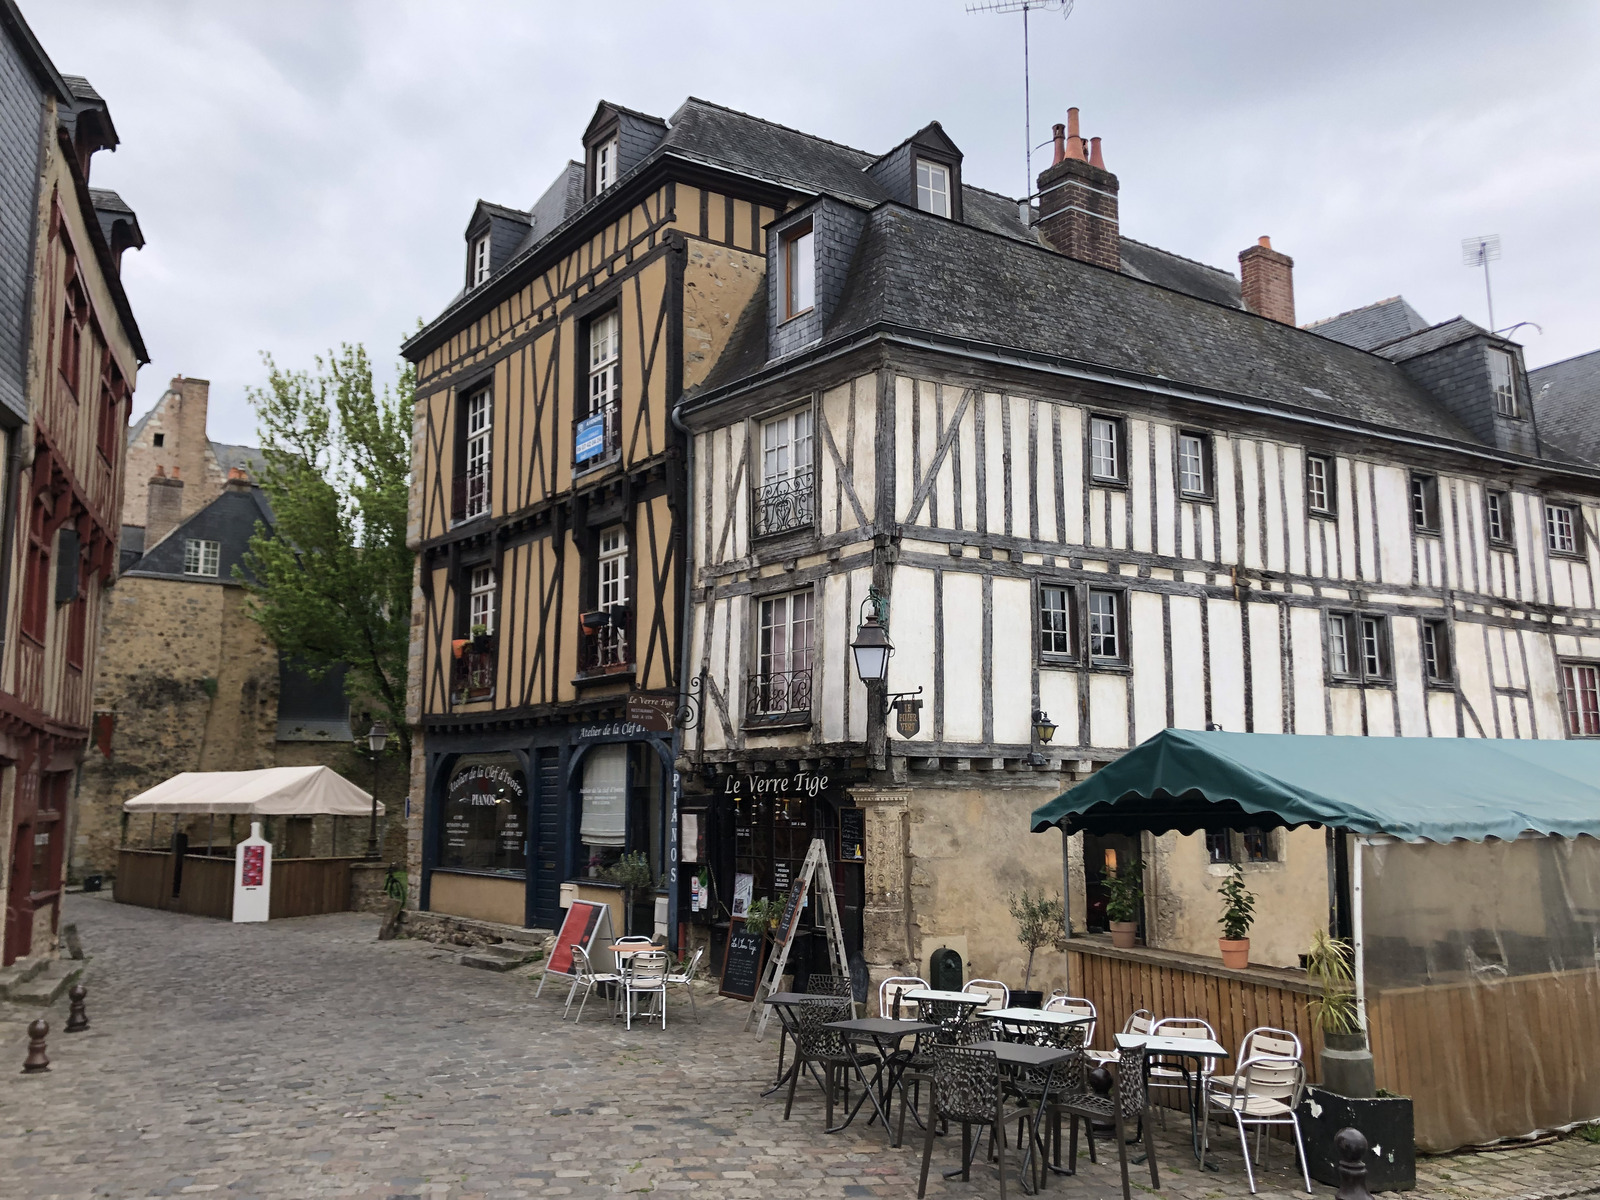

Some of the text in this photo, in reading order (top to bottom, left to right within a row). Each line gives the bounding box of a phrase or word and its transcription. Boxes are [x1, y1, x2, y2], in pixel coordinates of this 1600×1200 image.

[628, 696, 675, 708] Le Verre Tige
[904, 704, 911, 712] LE
[579, 725, 603, 739] Atelier
[603, 724, 611, 736] de
[613, 723, 619, 735] la
[621, 722, 635, 737] Clef
[448, 765, 523, 799] Atelier de la Clef d'Ivoire
[724, 771, 829, 797] Le Verre Tige
[471, 794, 496, 806] PIANOS
[670, 773, 680, 882] PIANOS
